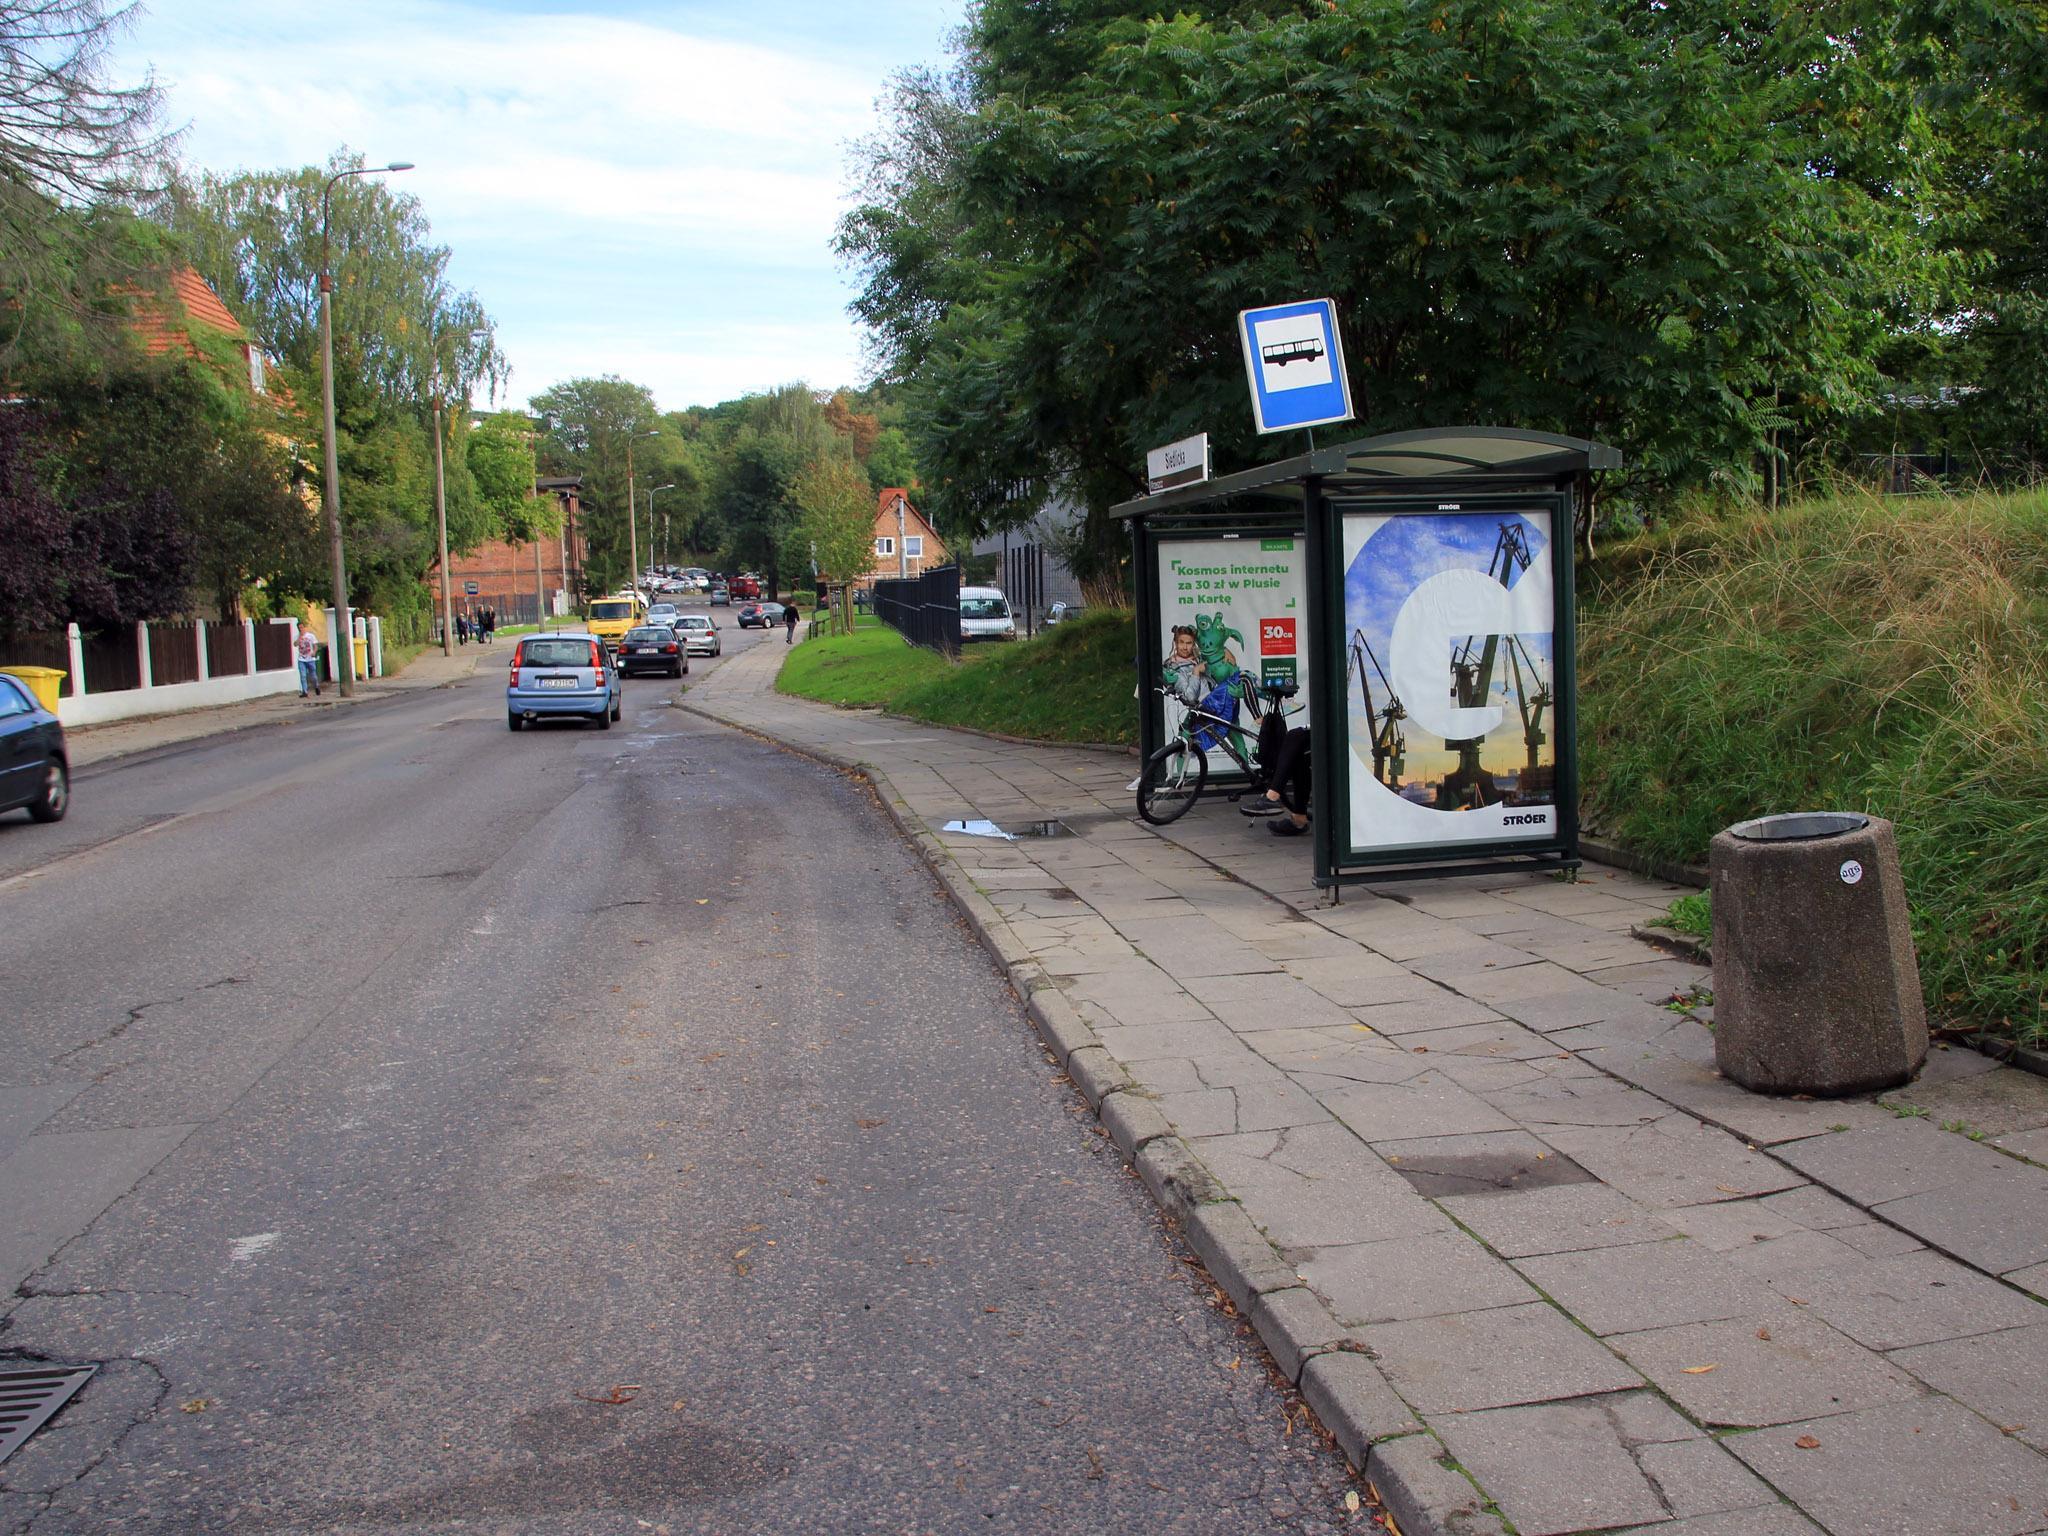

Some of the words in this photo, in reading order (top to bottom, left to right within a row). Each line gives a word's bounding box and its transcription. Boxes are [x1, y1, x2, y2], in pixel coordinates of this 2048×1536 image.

[1178, 566, 1227, 576] Kosmos
[1230, 564, 1289, 574] internetu
[1178, 582, 1192, 590] za
[1195, 580, 1210, 589] 30
[1214, 579, 1225, 589] zł
[1229, 581, 1240, 589] w
[1243, 578, 1281, 588] Plusie
[1178, 595, 1194, 604] na
[1197, 594, 1232, 605] Kartę
[1503, 814, 1546, 825] STRÖER
